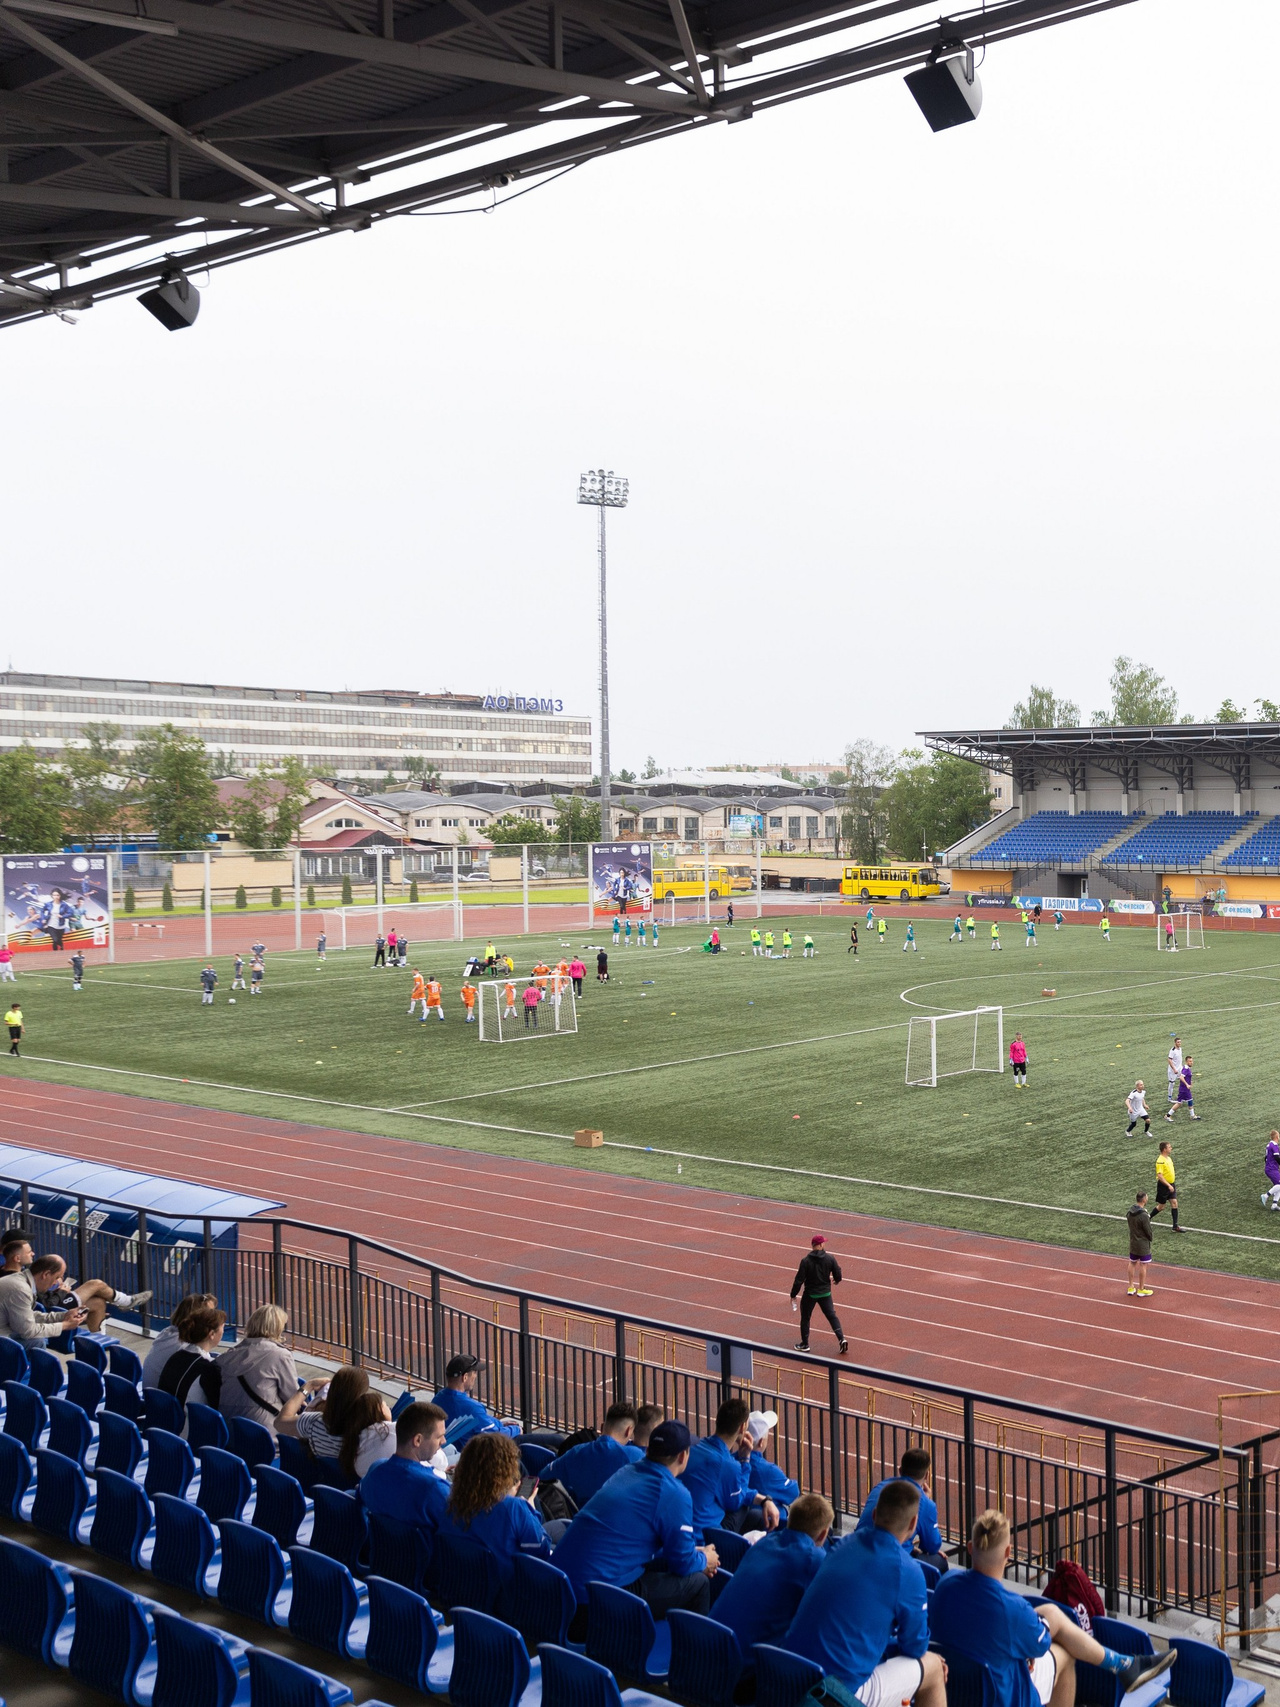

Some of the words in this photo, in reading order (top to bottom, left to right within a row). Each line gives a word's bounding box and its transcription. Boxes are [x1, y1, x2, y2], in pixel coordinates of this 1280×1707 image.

[483, 694, 509, 710] АО
[515, 696, 564, 712] ПЭМЗ
[1044, 899, 1077, 910] ГАЗПРОМ
[62, 1296, 74, 1305] 8
